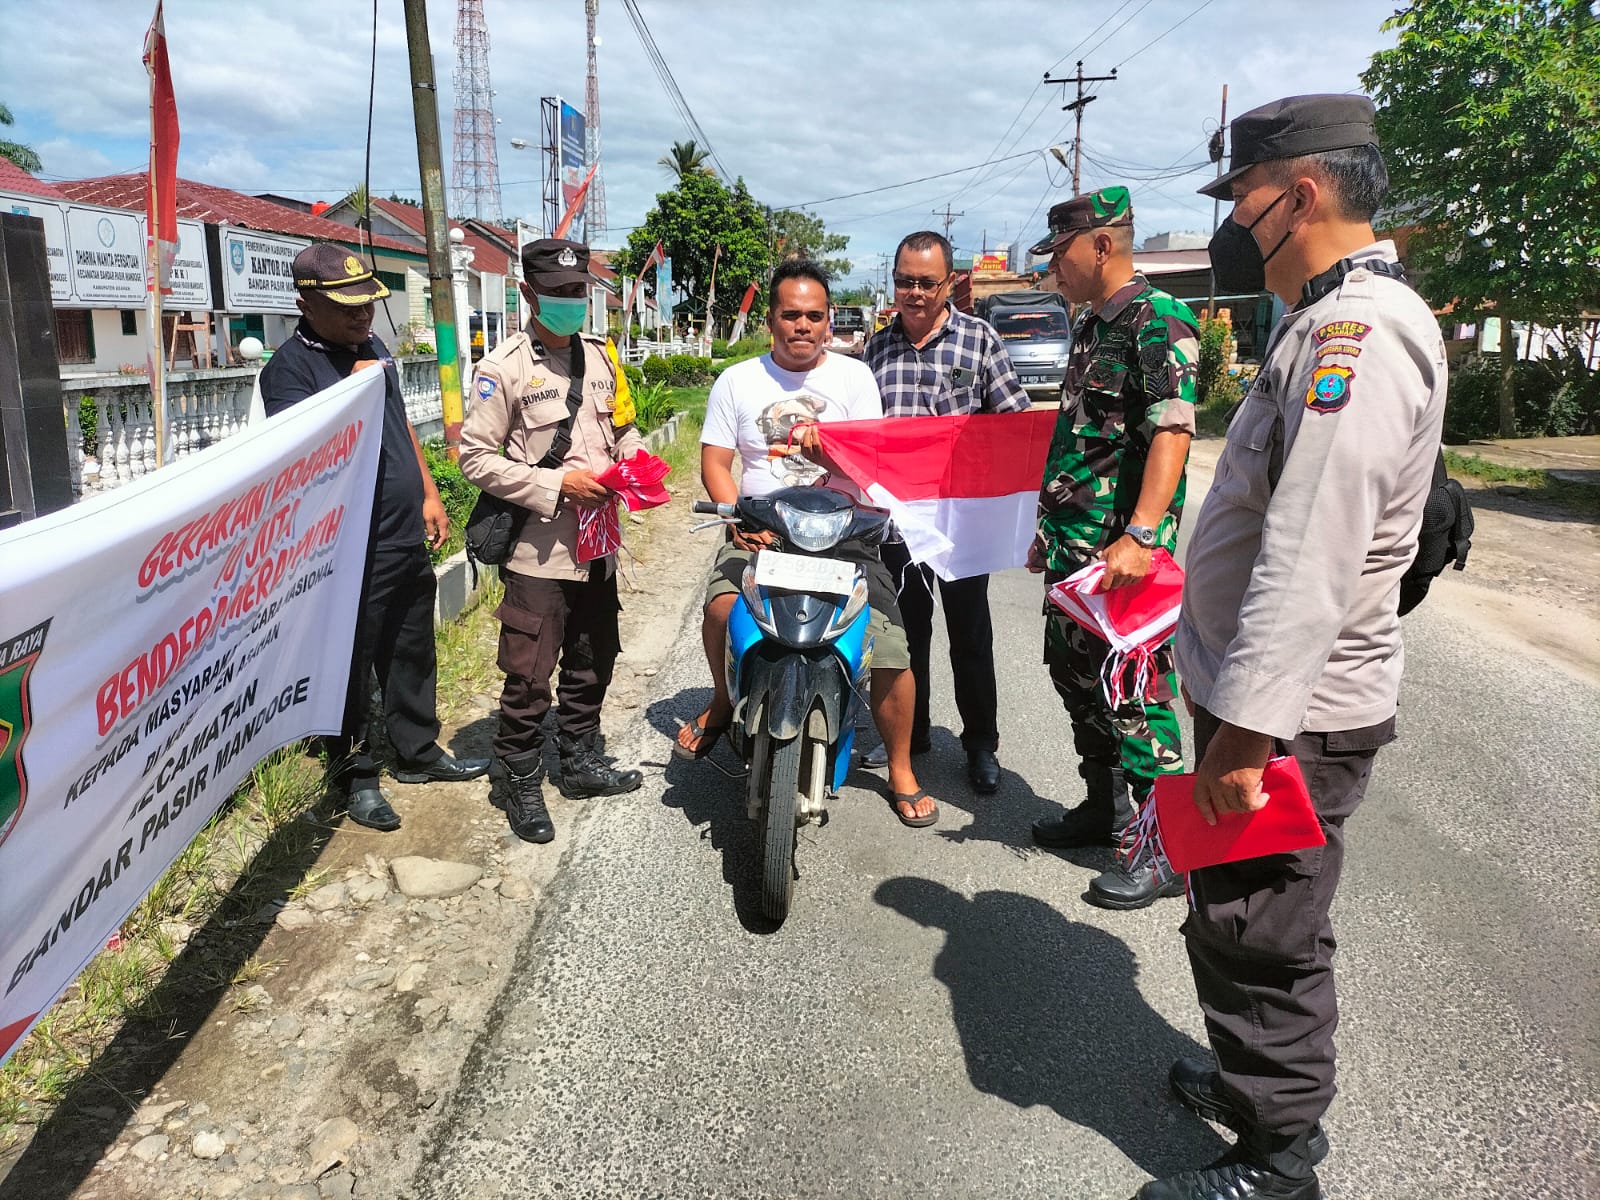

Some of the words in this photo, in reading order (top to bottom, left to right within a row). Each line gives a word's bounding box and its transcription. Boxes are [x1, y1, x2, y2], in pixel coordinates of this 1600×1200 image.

[75, 249, 96, 266] DHARMA
[96, 252, 114, 267] WANITA
[114, 253, 139, 269] PERSATUAN
[270, 244, 293, 257] KABUPATEN
[78, 269, 99, 279] KECAMATAN
[100, 270, 115, 280] BANDAR
[251, 256, 281, 276] KANTOR
[248, 278, 270, 290] BANDAR
[271, 280, 285, 291] PASIR
[1319, 321, 1366, 338] POLRES
[521, 388, 561, 406] SUHARDI
[137, 477, 273, 589] GERAKAN
[8, 628, 44, 663] RAYA
[63, 724, 141, 810] KEPADA
[3, 837, 134, 999] BANDAR
[138, 763, 210, 855] PASIR
[211, 676, 311, 780] MANDOGE
